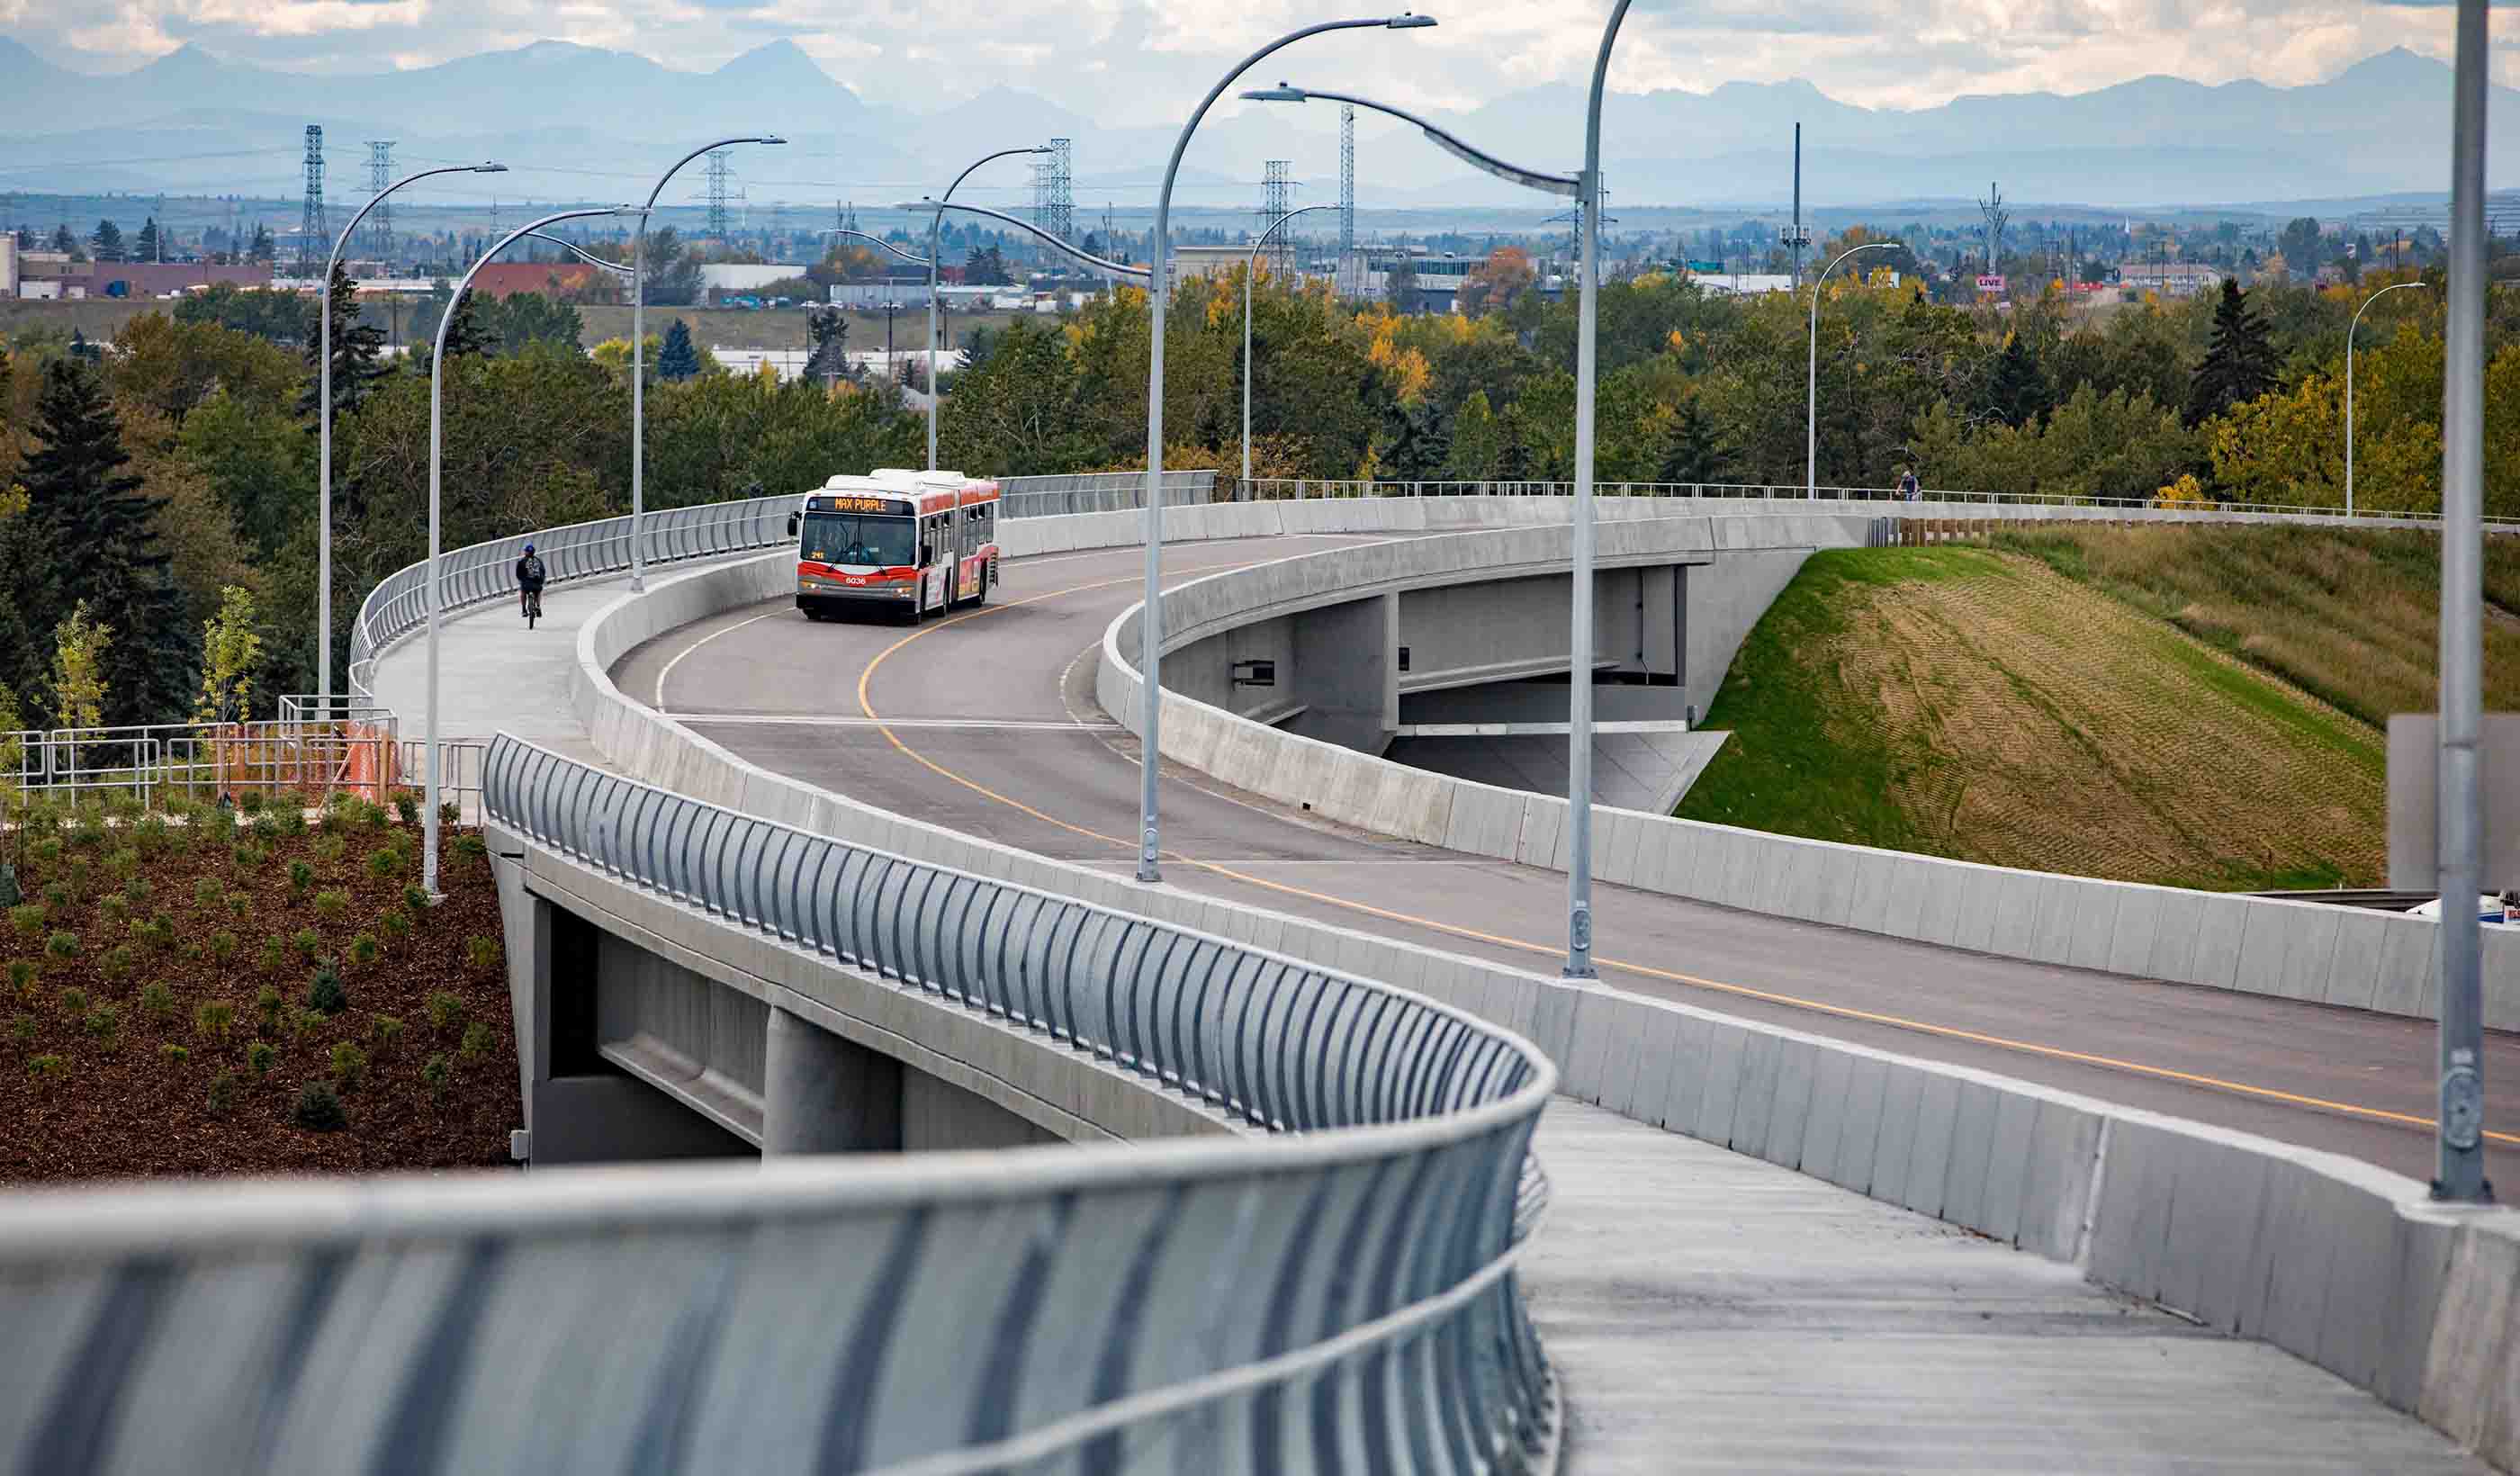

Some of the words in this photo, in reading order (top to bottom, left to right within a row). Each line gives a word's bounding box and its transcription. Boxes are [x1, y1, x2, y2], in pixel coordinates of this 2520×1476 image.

[835, 498, 853, 509] MAX
[855, 499, 886, 511] PURPLE
[846, 576, 866, 585] 6036
